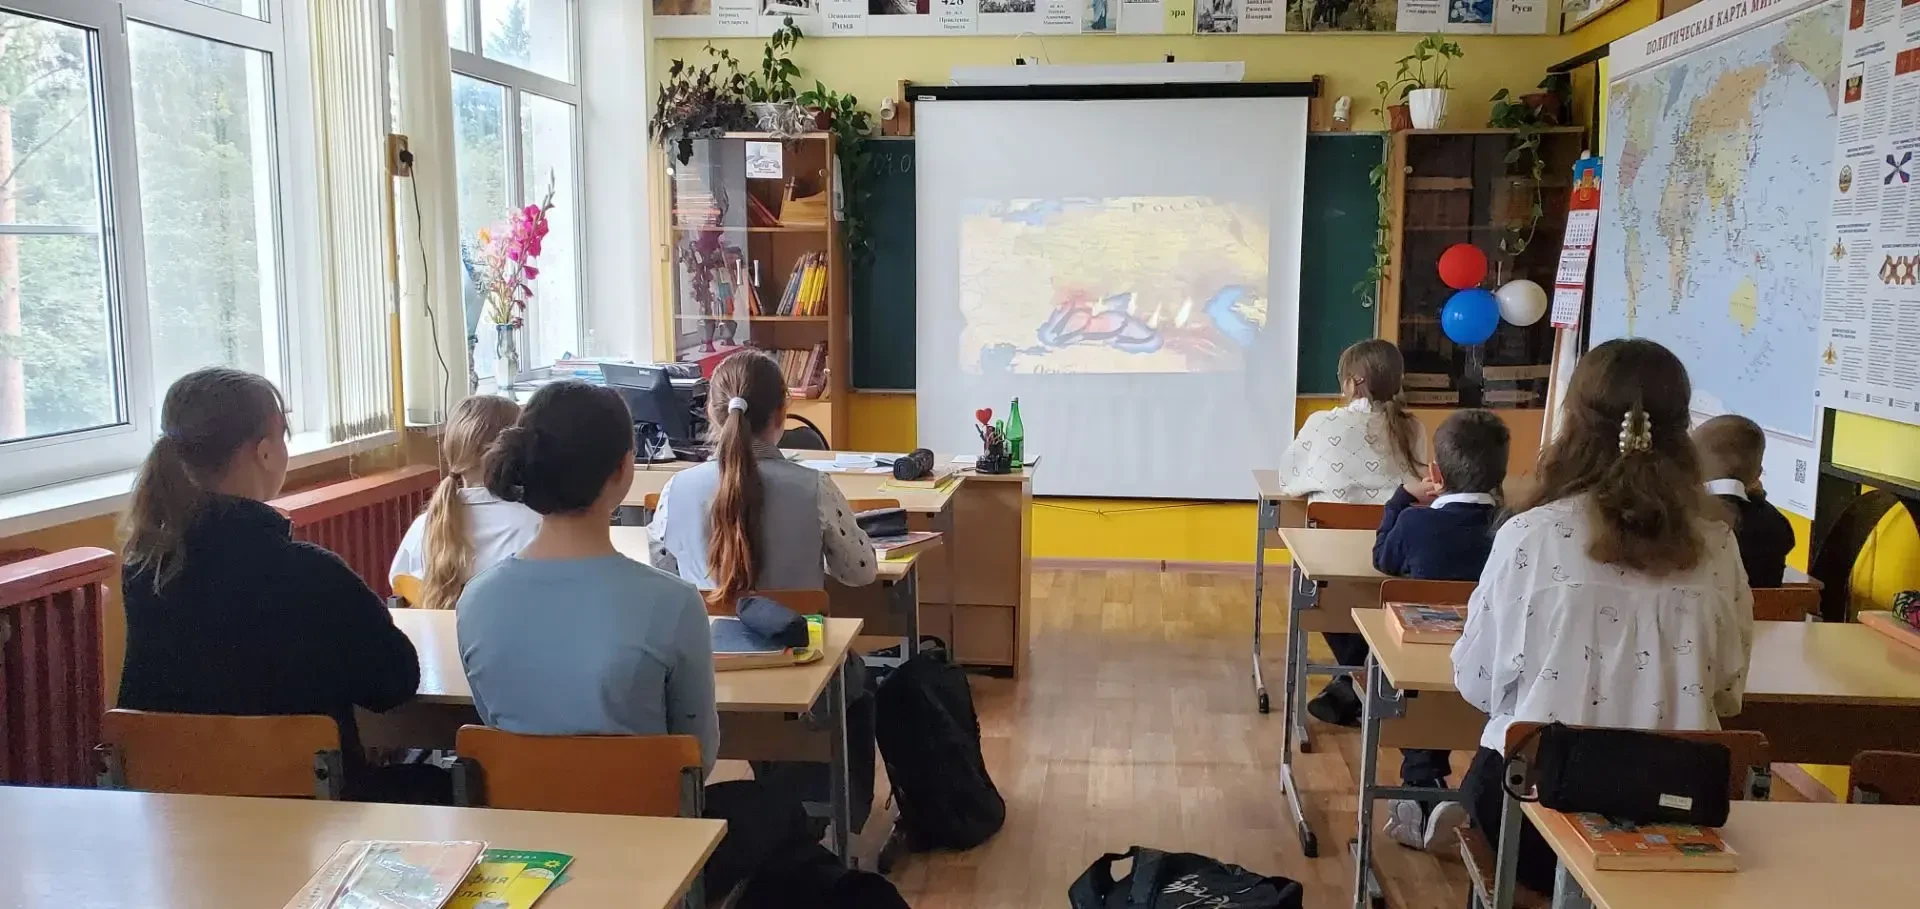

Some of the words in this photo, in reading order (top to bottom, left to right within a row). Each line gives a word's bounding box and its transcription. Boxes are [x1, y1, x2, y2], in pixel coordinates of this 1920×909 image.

[1171, 9, 1186, 19] эра
[1511, 3, 1533, 15] Руси
[1645, 14, 1715, 56] ПОЛИТИЧЕСКАЯ
[1716, 1, 1748, 28] КАРТА
